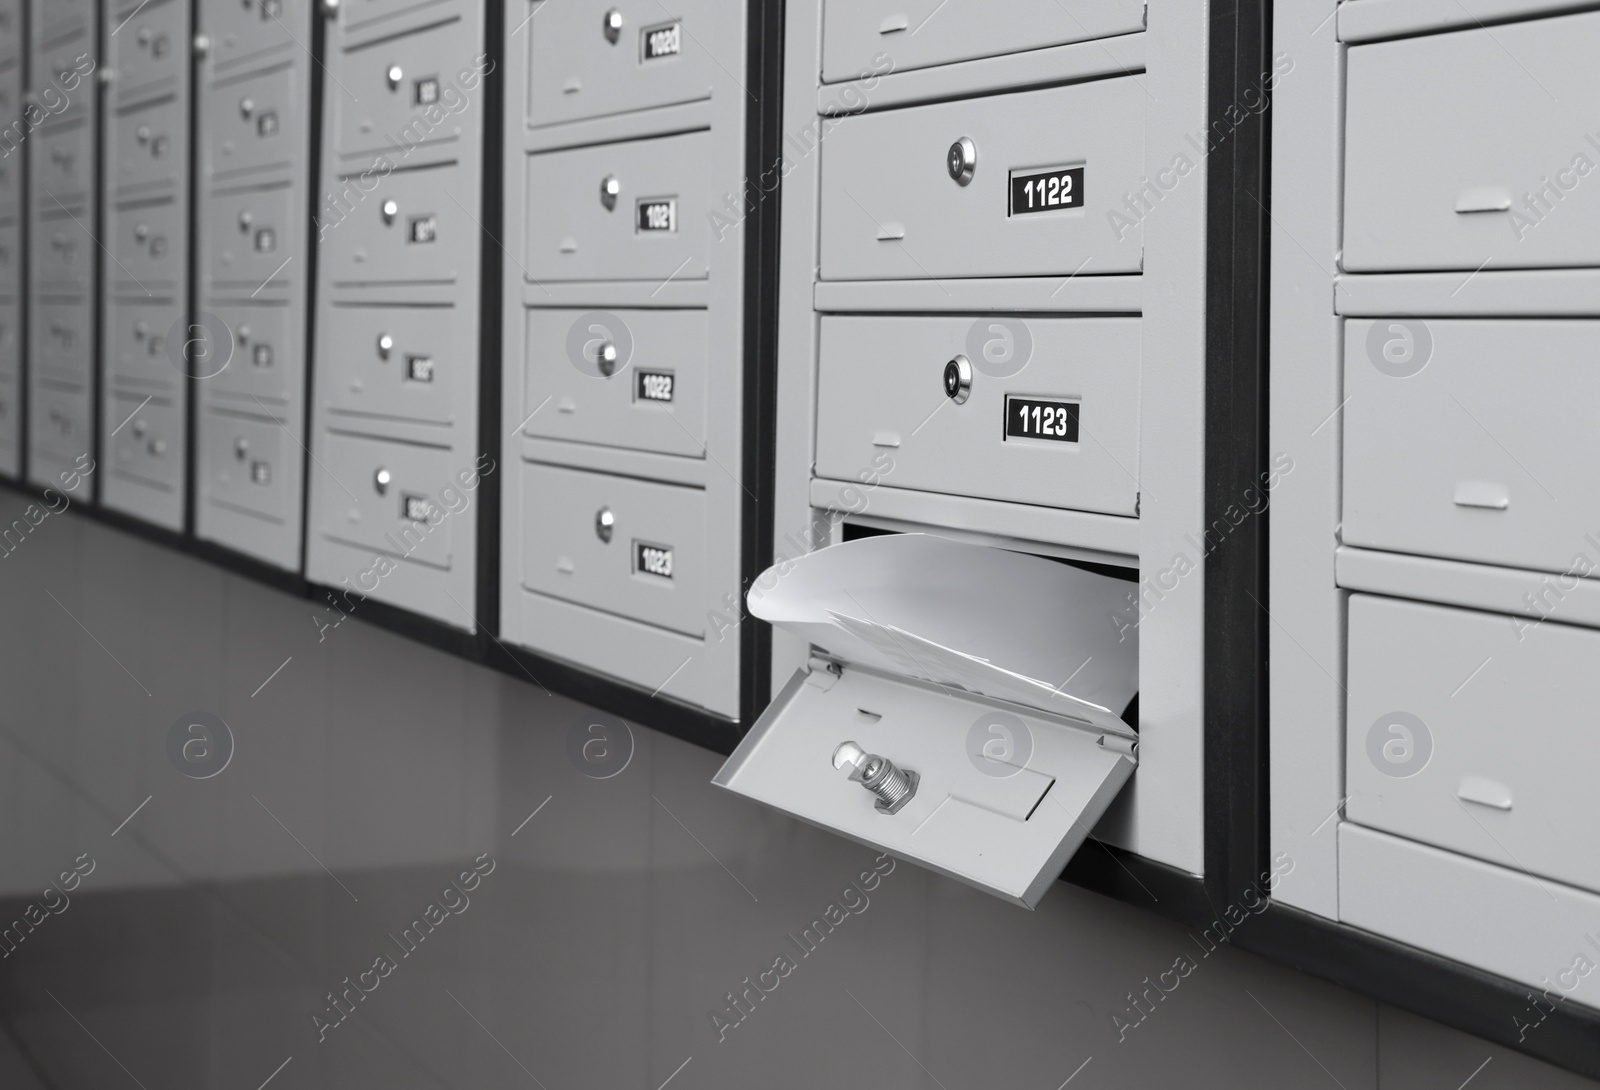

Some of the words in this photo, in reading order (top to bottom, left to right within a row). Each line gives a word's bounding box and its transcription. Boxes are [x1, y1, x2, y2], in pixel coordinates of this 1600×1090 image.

[650, 27, 680, 56] 1020
[1023, 175, 1073, 208] 1122
[643, 374, 672, 400] 1022
[1019, 405, 1067, 436] 1123
[642, 548, 672, 576] 1023
